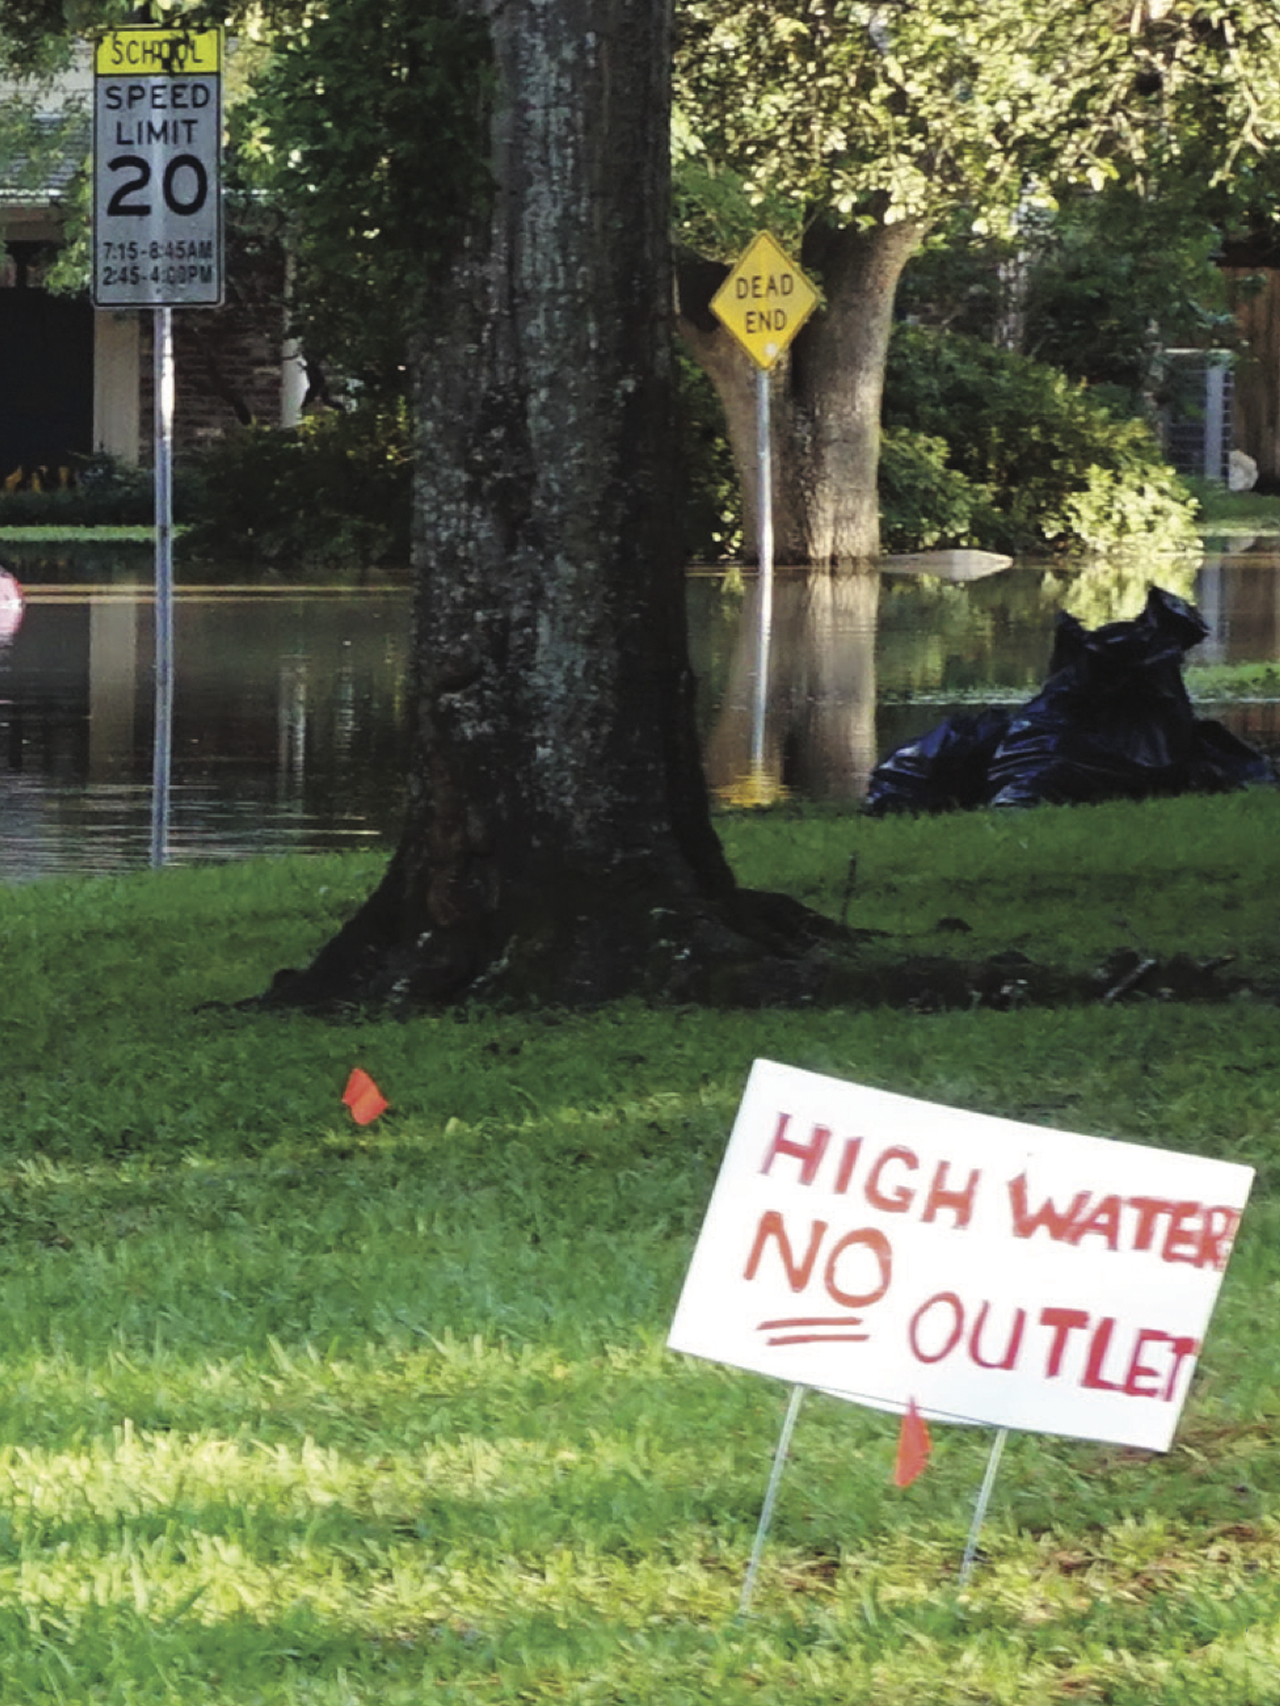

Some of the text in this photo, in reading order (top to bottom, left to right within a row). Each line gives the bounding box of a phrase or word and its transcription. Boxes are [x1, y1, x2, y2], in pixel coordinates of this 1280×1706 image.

[111, 40, 203, 65] SCHOOL
[105, 85, 210, 110] SPEED
[116, 119, 199, 145] LIMIT
[107, 154, 208, 216] 20
[736, 274, 793, 299] DEAD
[746, 309, 787, 334] END
[760, 1112, 1242, 1272] HIGH WATER
[743, 1210, 1199, 1403] NO OUTLET
